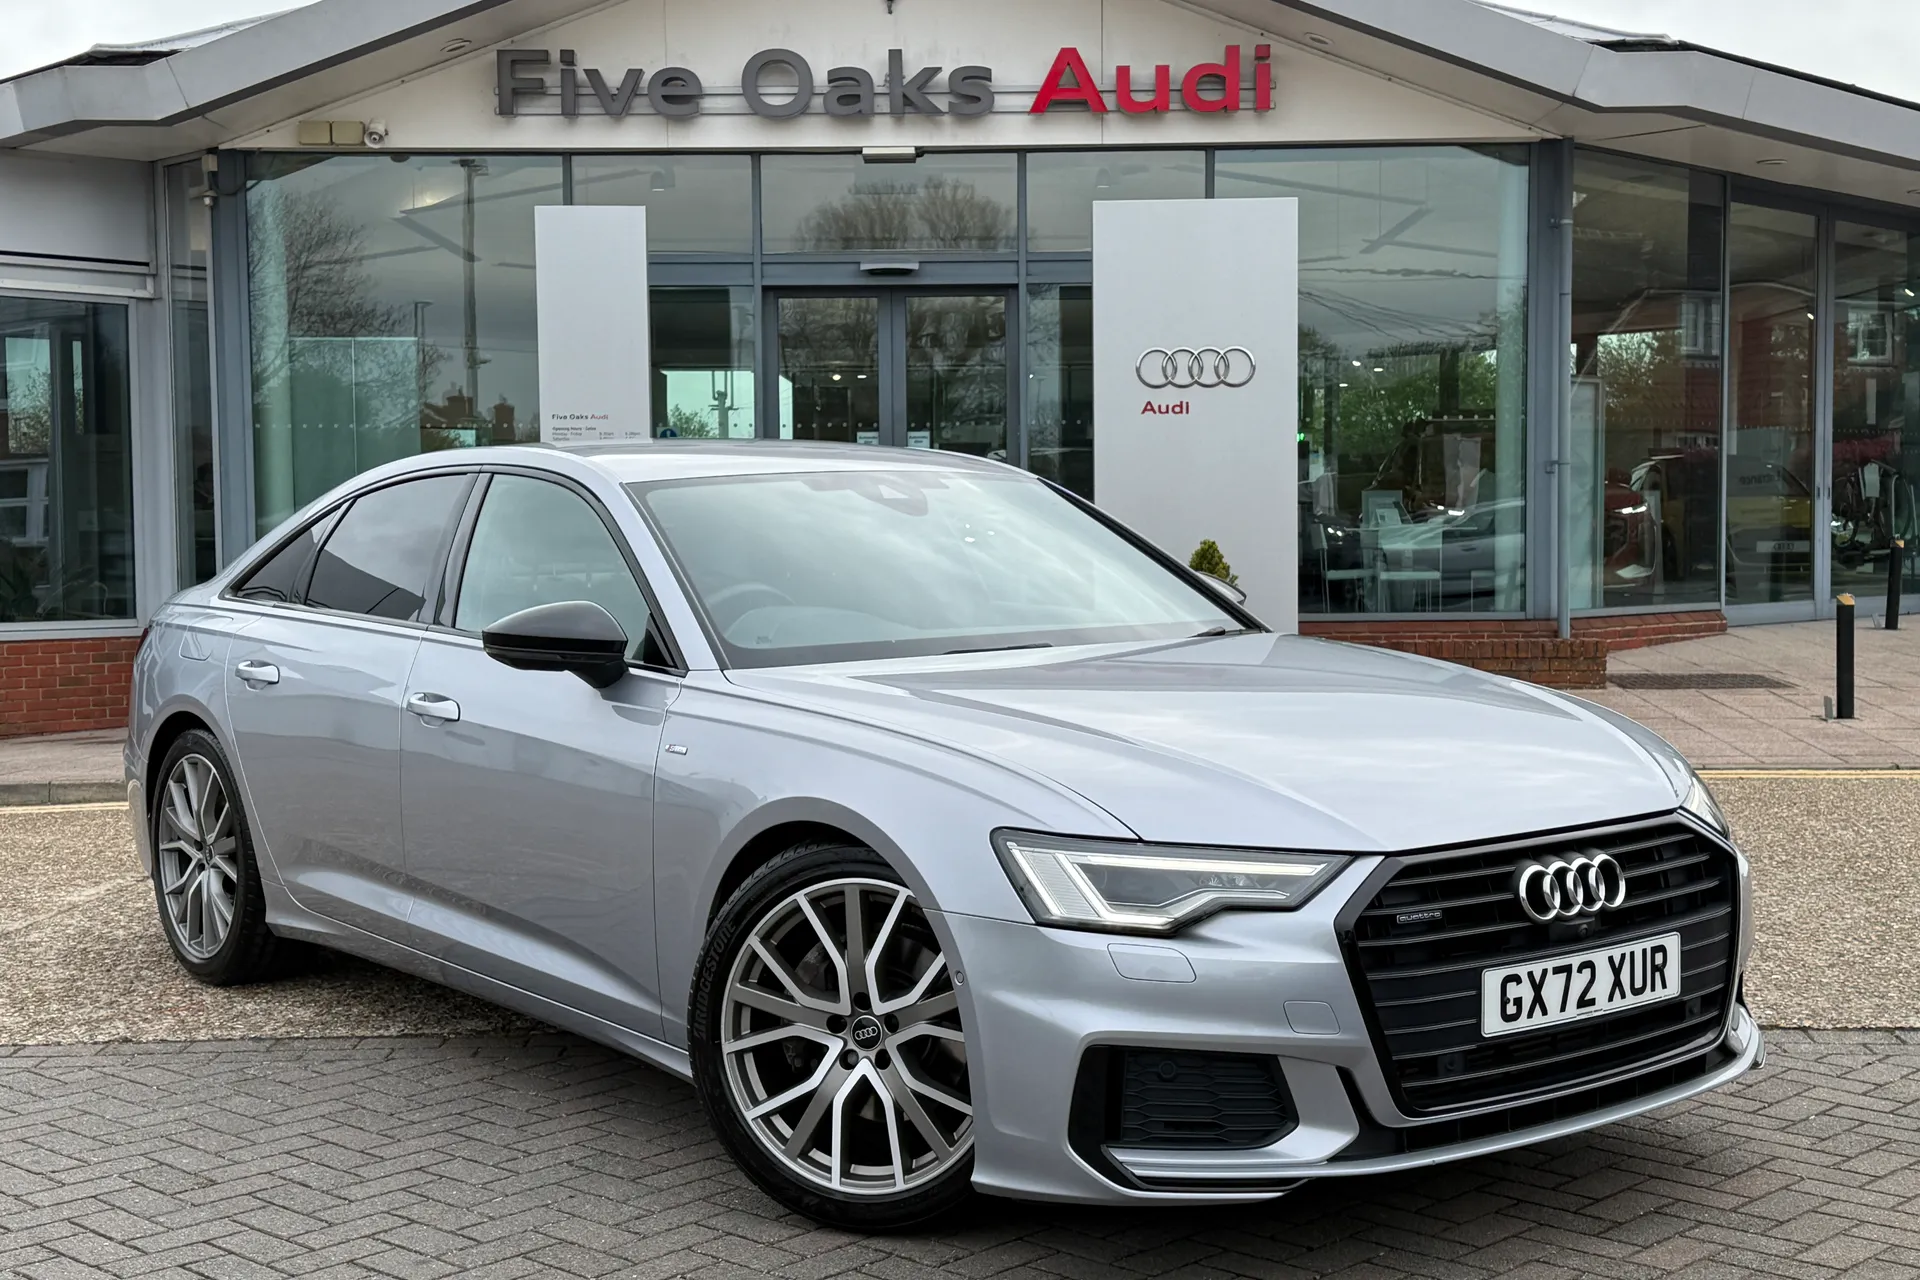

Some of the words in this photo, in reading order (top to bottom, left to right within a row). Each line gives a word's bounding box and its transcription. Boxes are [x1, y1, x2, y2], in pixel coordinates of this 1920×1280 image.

[497, 48, 703, 117] Five
[741, 47, 994, 119] Oaks
[1028, 44, 1272, 115] Audi
[1140, 400, 1190, 415] Audi
[1399, 911, 1441, 922] quattro
[1500, 959, 1597, 1023] GX72
[1607, 943, 1668, 1003] XUR
